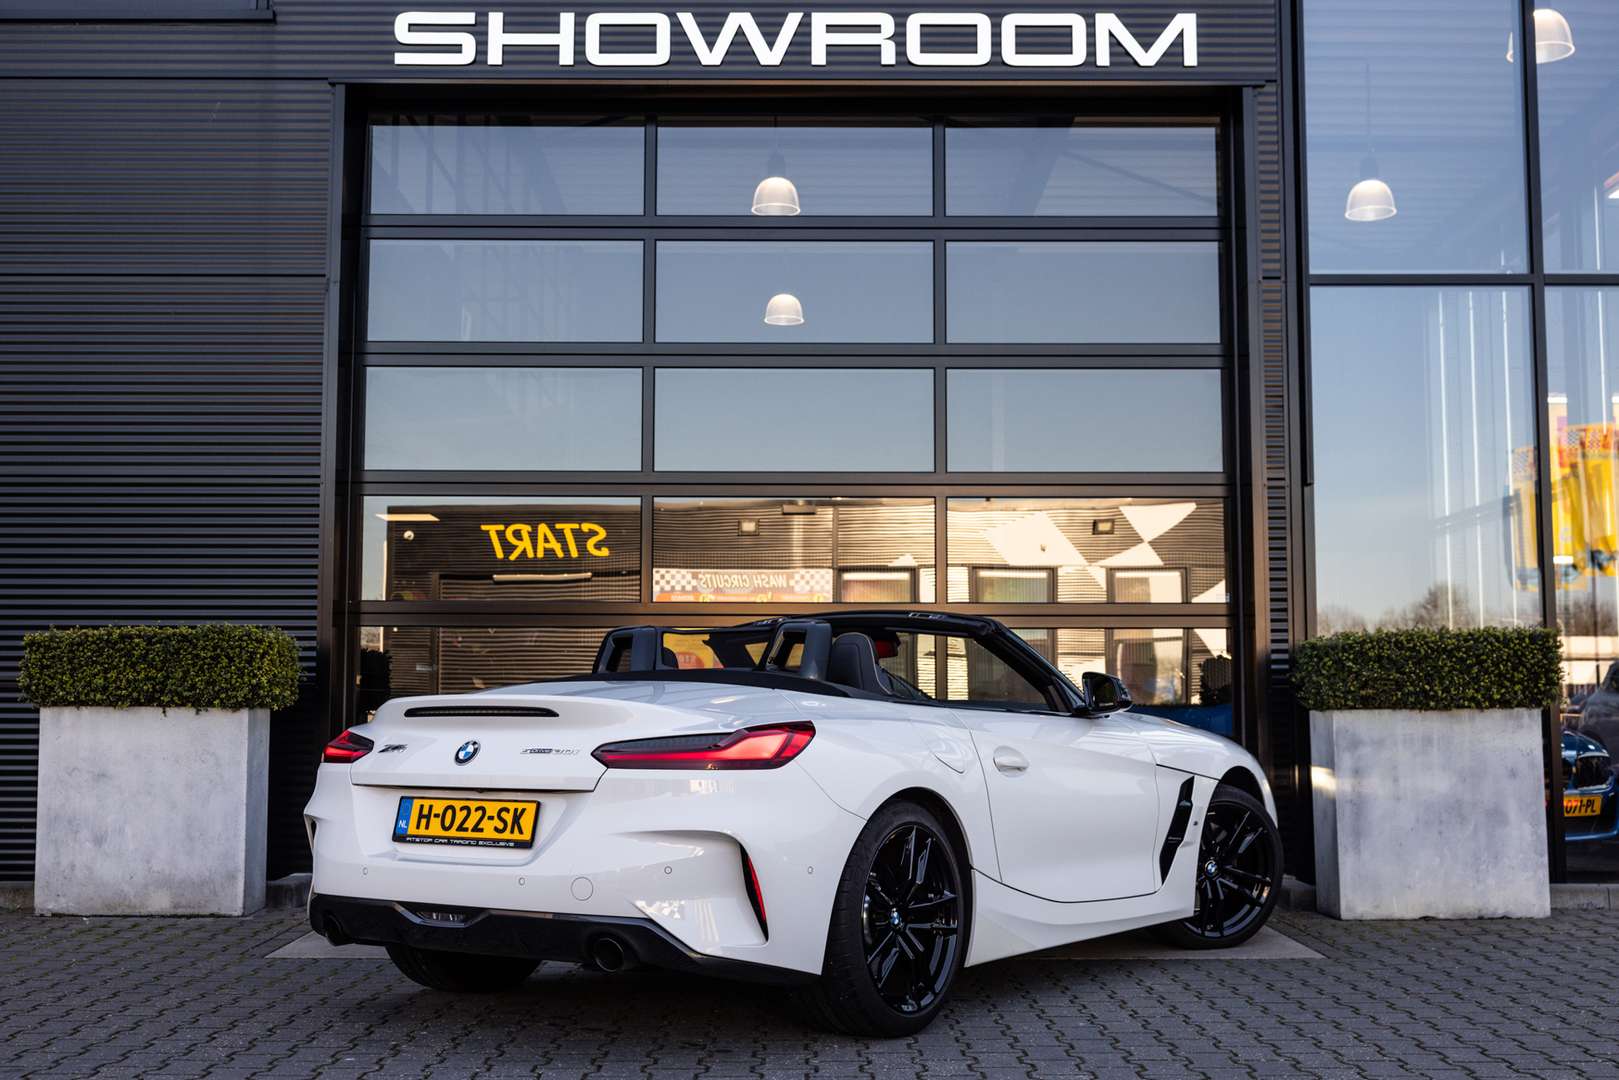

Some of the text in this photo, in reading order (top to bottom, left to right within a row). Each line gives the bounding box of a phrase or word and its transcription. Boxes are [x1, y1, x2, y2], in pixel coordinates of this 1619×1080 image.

[393, 11, 1199, 67] SHOWROOM
[398, 819, 408, 829] NL
[415, 804, 527, 835] H-022-SK
